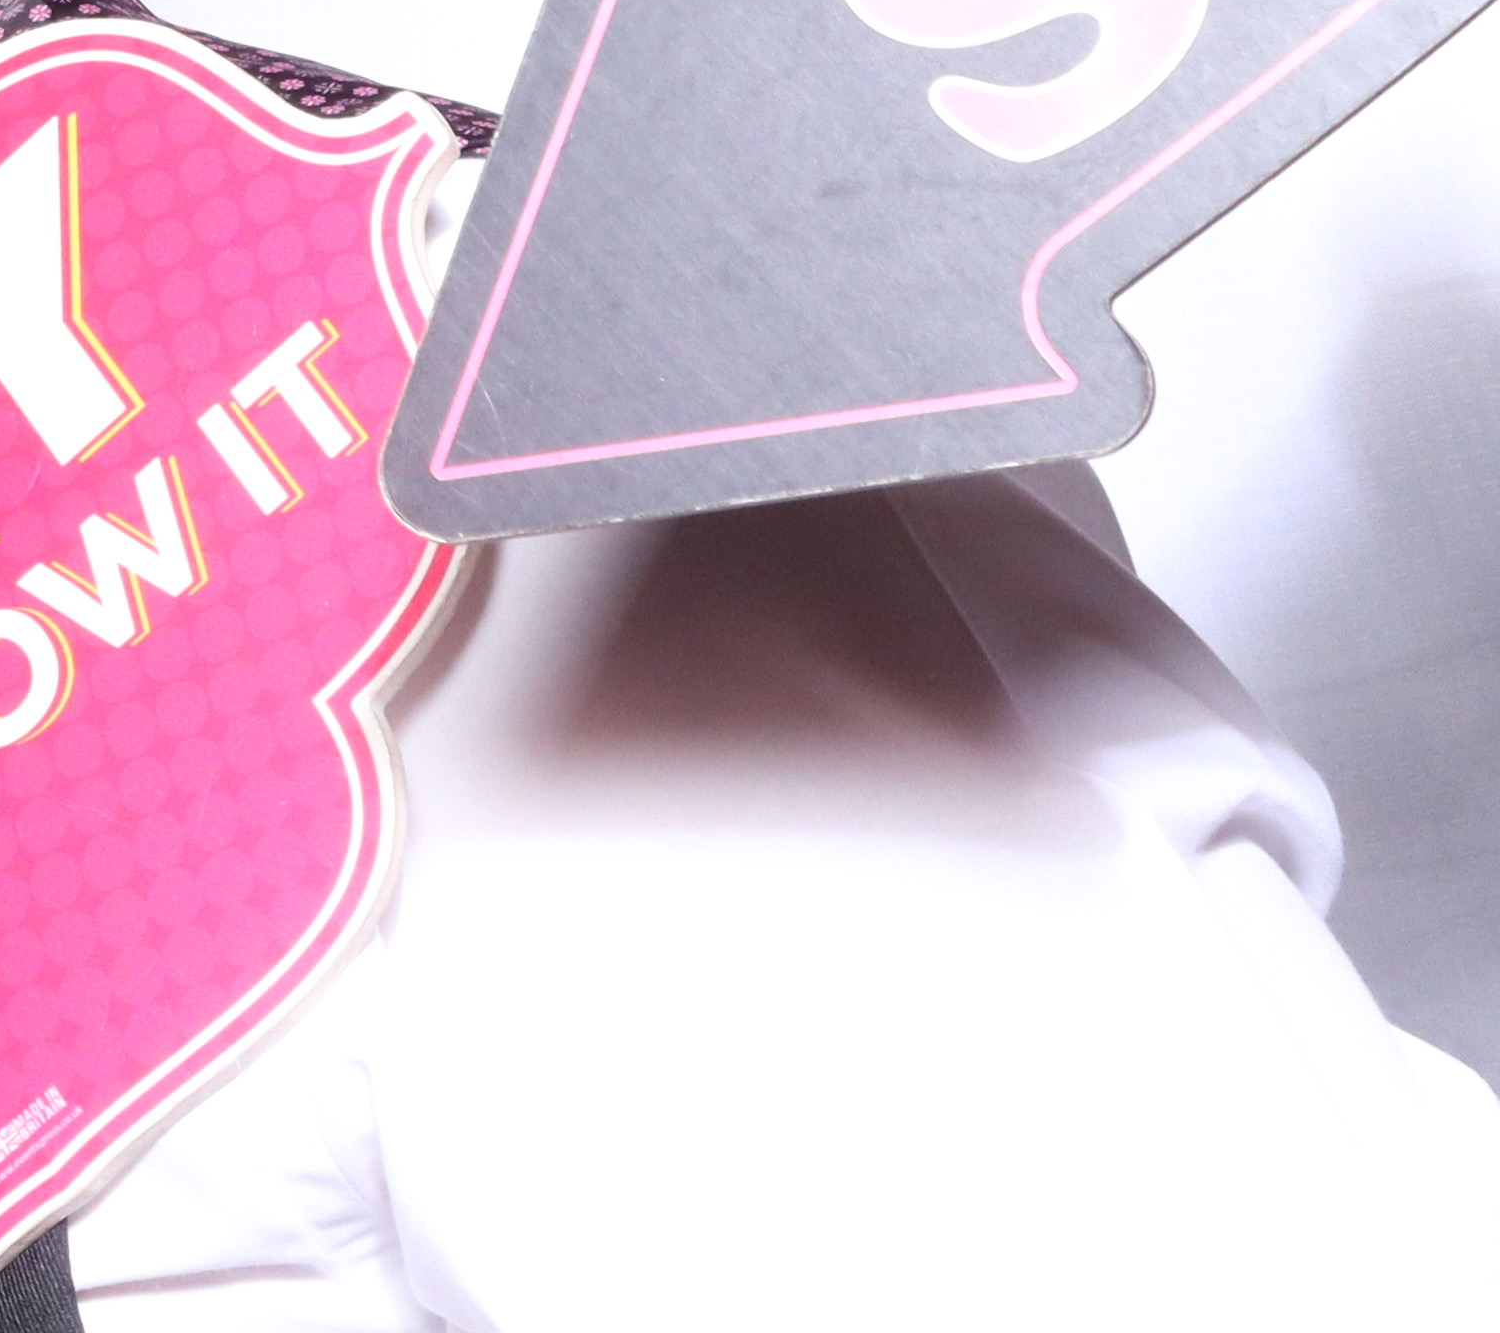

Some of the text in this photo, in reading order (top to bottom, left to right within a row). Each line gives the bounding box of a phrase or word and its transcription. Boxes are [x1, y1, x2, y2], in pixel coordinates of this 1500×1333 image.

[200, 319, 368, 514] IT
[12, 1096, 49, 1131] MADE
[19, 1097, 67, 1140] BRITAIN
